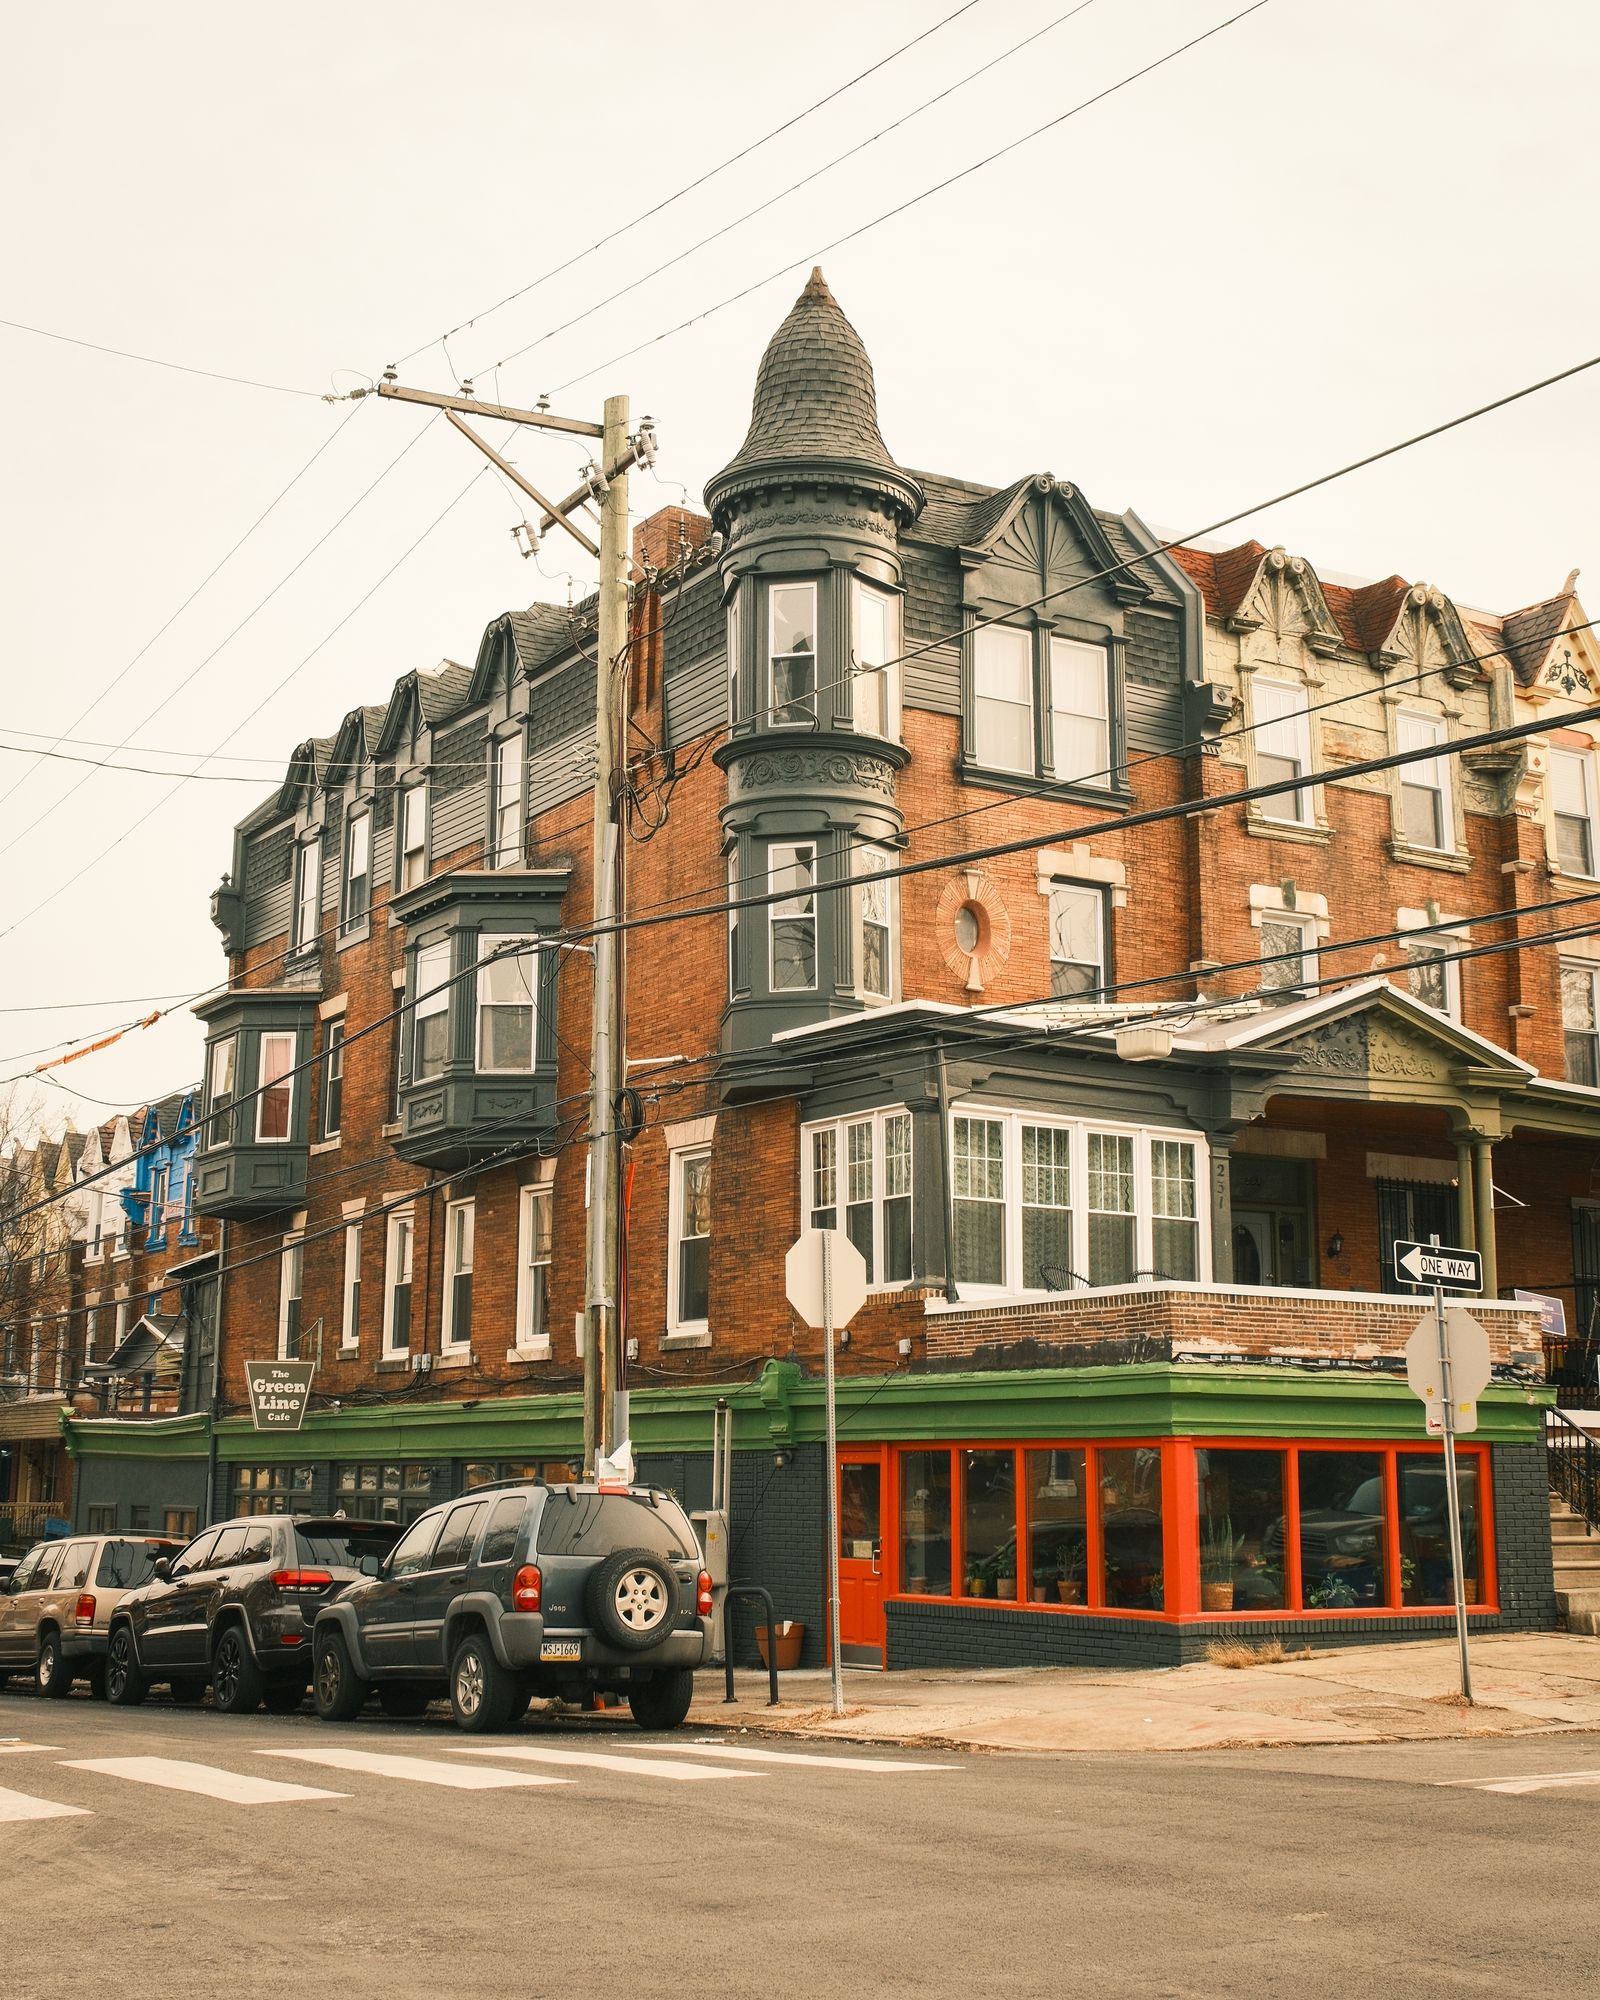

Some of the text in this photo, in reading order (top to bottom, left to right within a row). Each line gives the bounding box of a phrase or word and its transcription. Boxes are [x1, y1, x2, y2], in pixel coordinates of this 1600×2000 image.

[1420, 1257, 1471, 1278] ONE WAY
[271, 1370, 290, 1378] The
[252, 1378, 306, 1393] Green
[258, 1395, 300, 1410] Line
[267, 1412, 290, 1421] Cafe
[548, 1604, 567, 1612] Jeep
